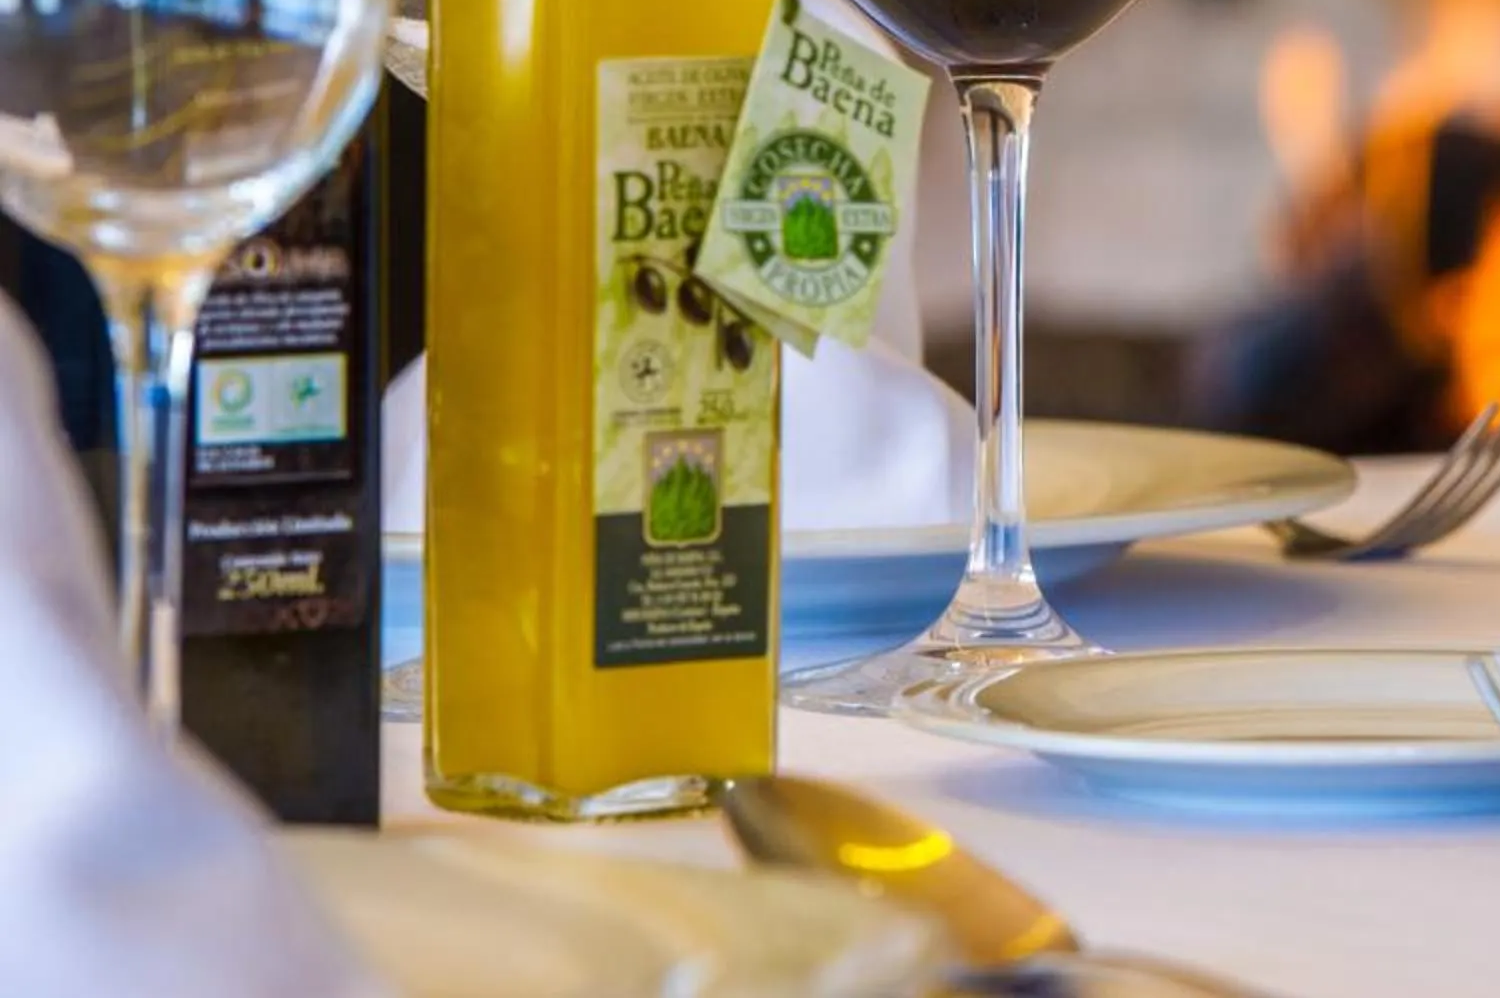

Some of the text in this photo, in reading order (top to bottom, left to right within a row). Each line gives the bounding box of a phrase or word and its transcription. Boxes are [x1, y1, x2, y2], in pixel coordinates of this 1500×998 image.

[780, 29, 896, 138] Baena
[820, 39, 897, 105] Peña de
[748, 136, 866, 197] COSECHA
[611, 169, 708, 243] Bae
[765, 261, 863, 301] PROPIA
